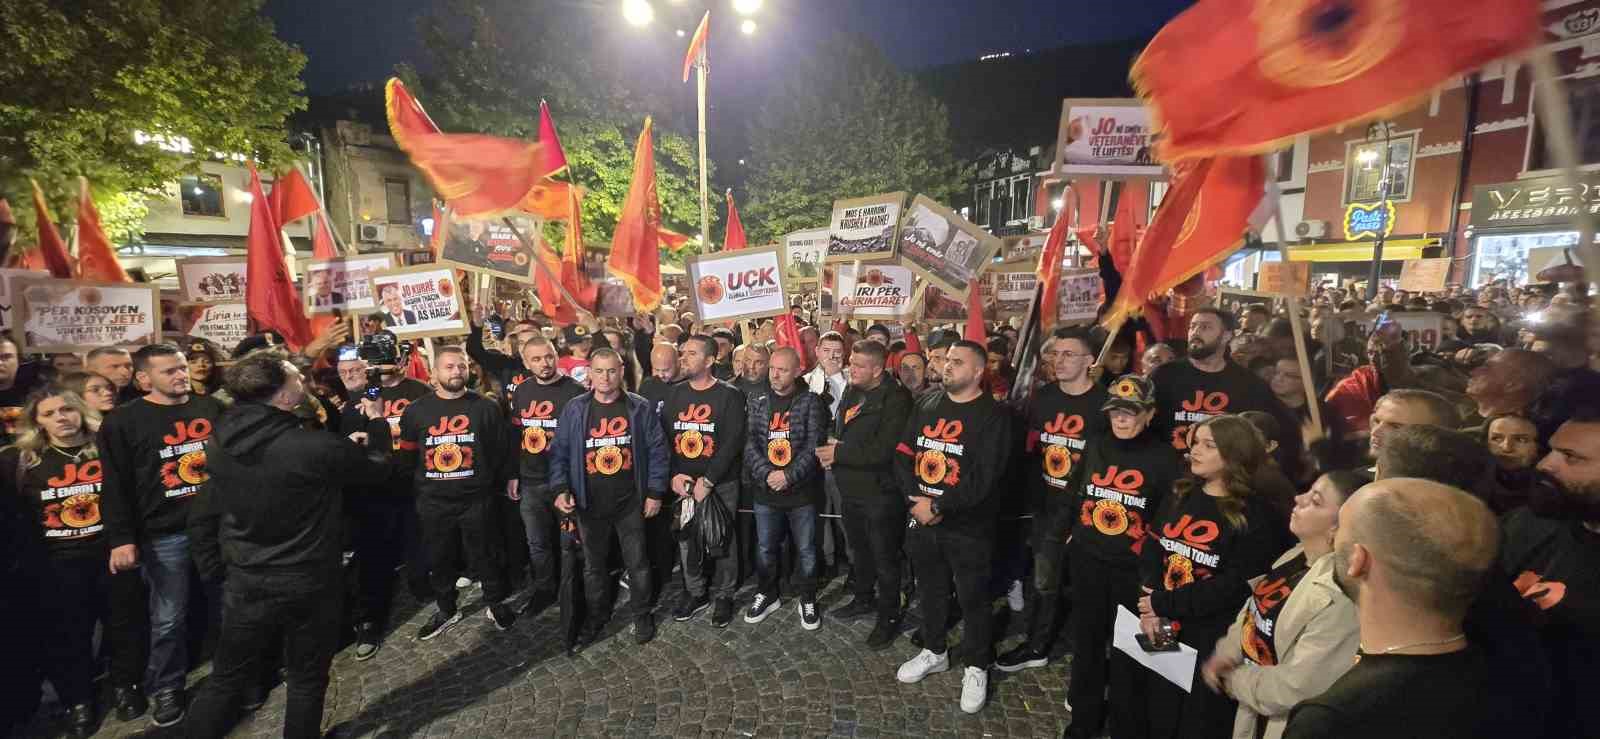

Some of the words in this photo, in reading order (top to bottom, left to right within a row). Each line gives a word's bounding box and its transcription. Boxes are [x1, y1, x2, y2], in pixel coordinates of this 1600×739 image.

[1092, 118, 1115, 135] JO
[845, 209, 858, 218] MOS
[877, 284, 901, 296] PËR
[111, 313, 145, 324] JETË
[418, 310, 428, 321] AS
[521, 400, 554, 418] JO
[1183, 390, 1229, 411] JO
[679, 403, 712, 422] JO
[164, 417, 212, 445] JO
[428, 415, 470, 435] JO
[591, 416, 628, 437] JO
[923, 418, 963, 439] JO
[1044, 412, 1085, 434] JO
[48, 460, 103, 488] JO
[1092, 465, 1145, 489] JO
[1095, 486, 1122, 503] EMRIN
[1123, 494, 1147, 509] TONË
[1163, 514, 1219, 543] JO
[1191, 548, 1220, 568] TONË
